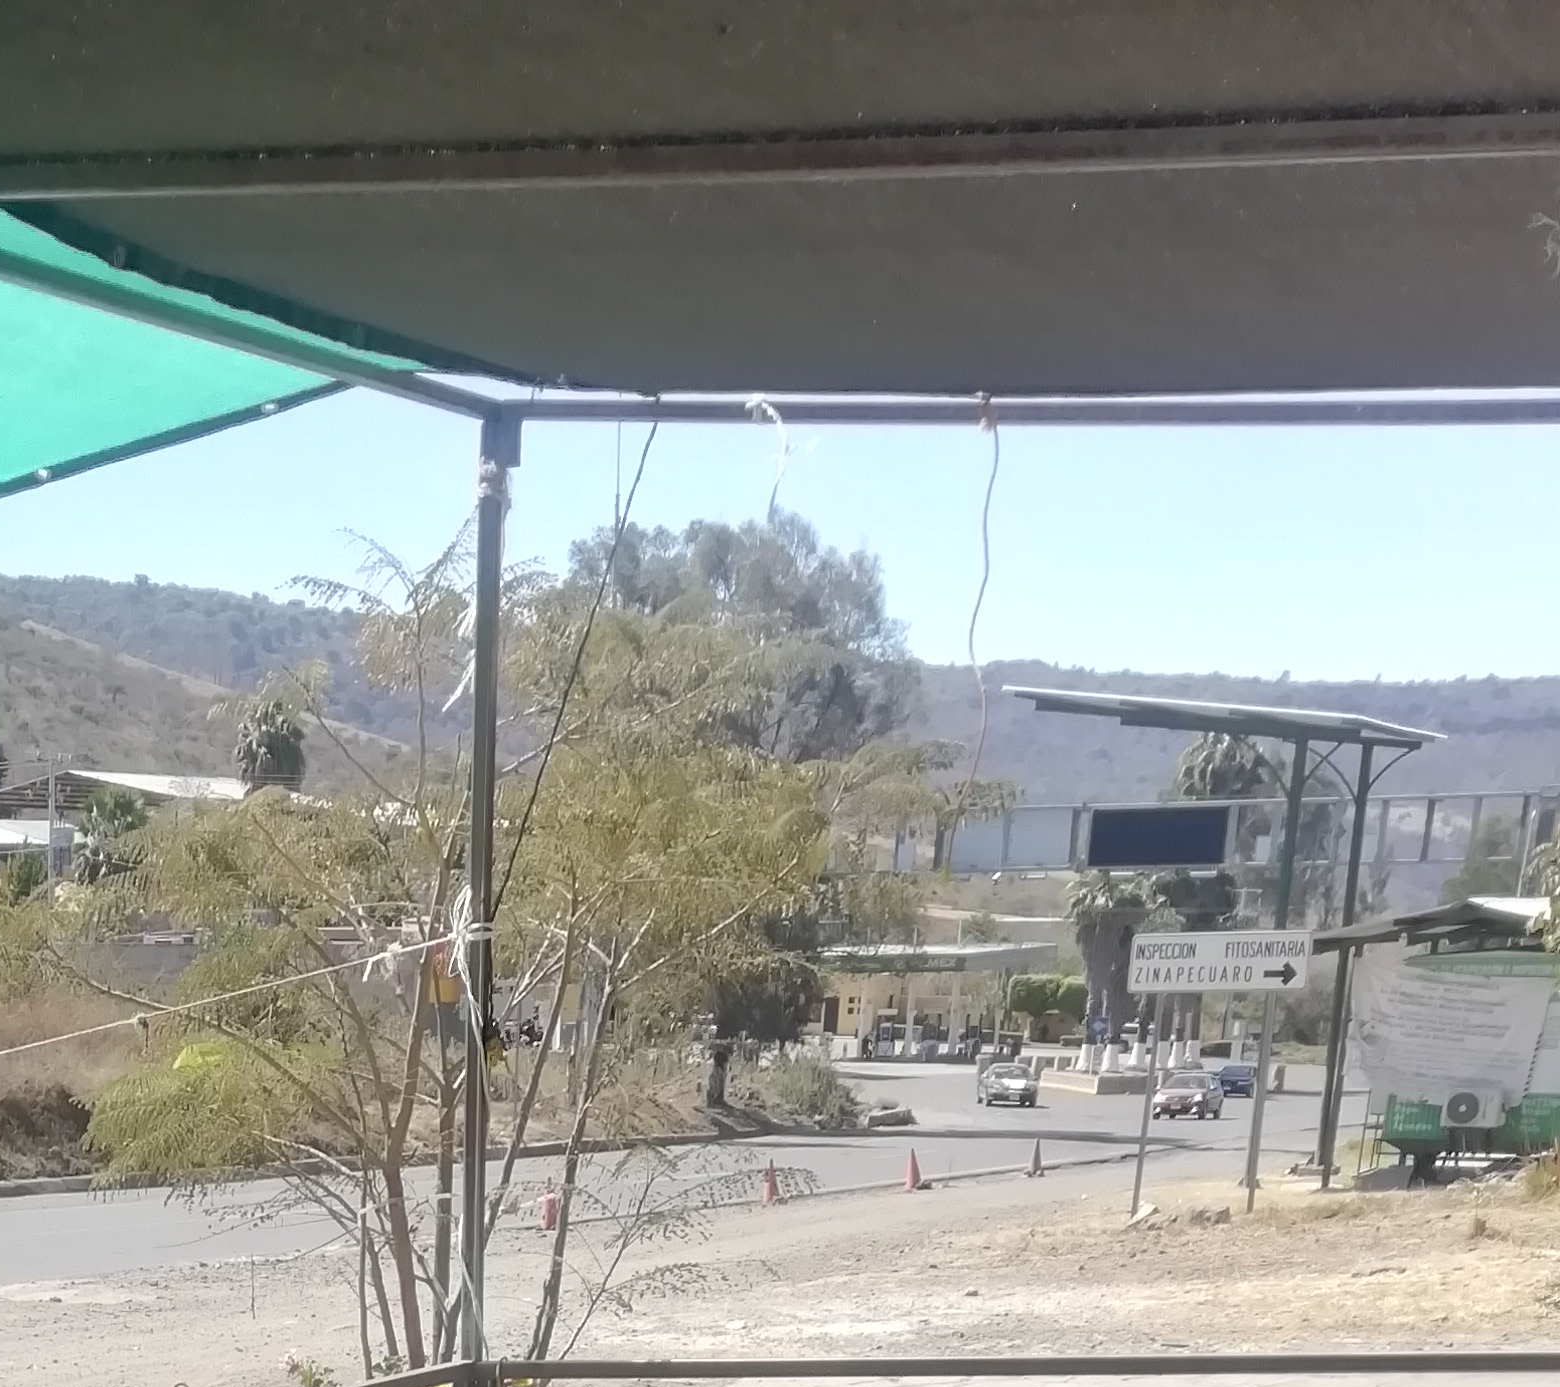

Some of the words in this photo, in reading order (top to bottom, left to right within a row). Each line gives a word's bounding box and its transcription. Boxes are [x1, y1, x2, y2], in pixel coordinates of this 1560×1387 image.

[1134, 942, 1197, 960] INSPECCION
[1224, 940, 1307, 959] FITOSANITARIA
[1134, 965, 1254, 984] ZINAPECUARO
